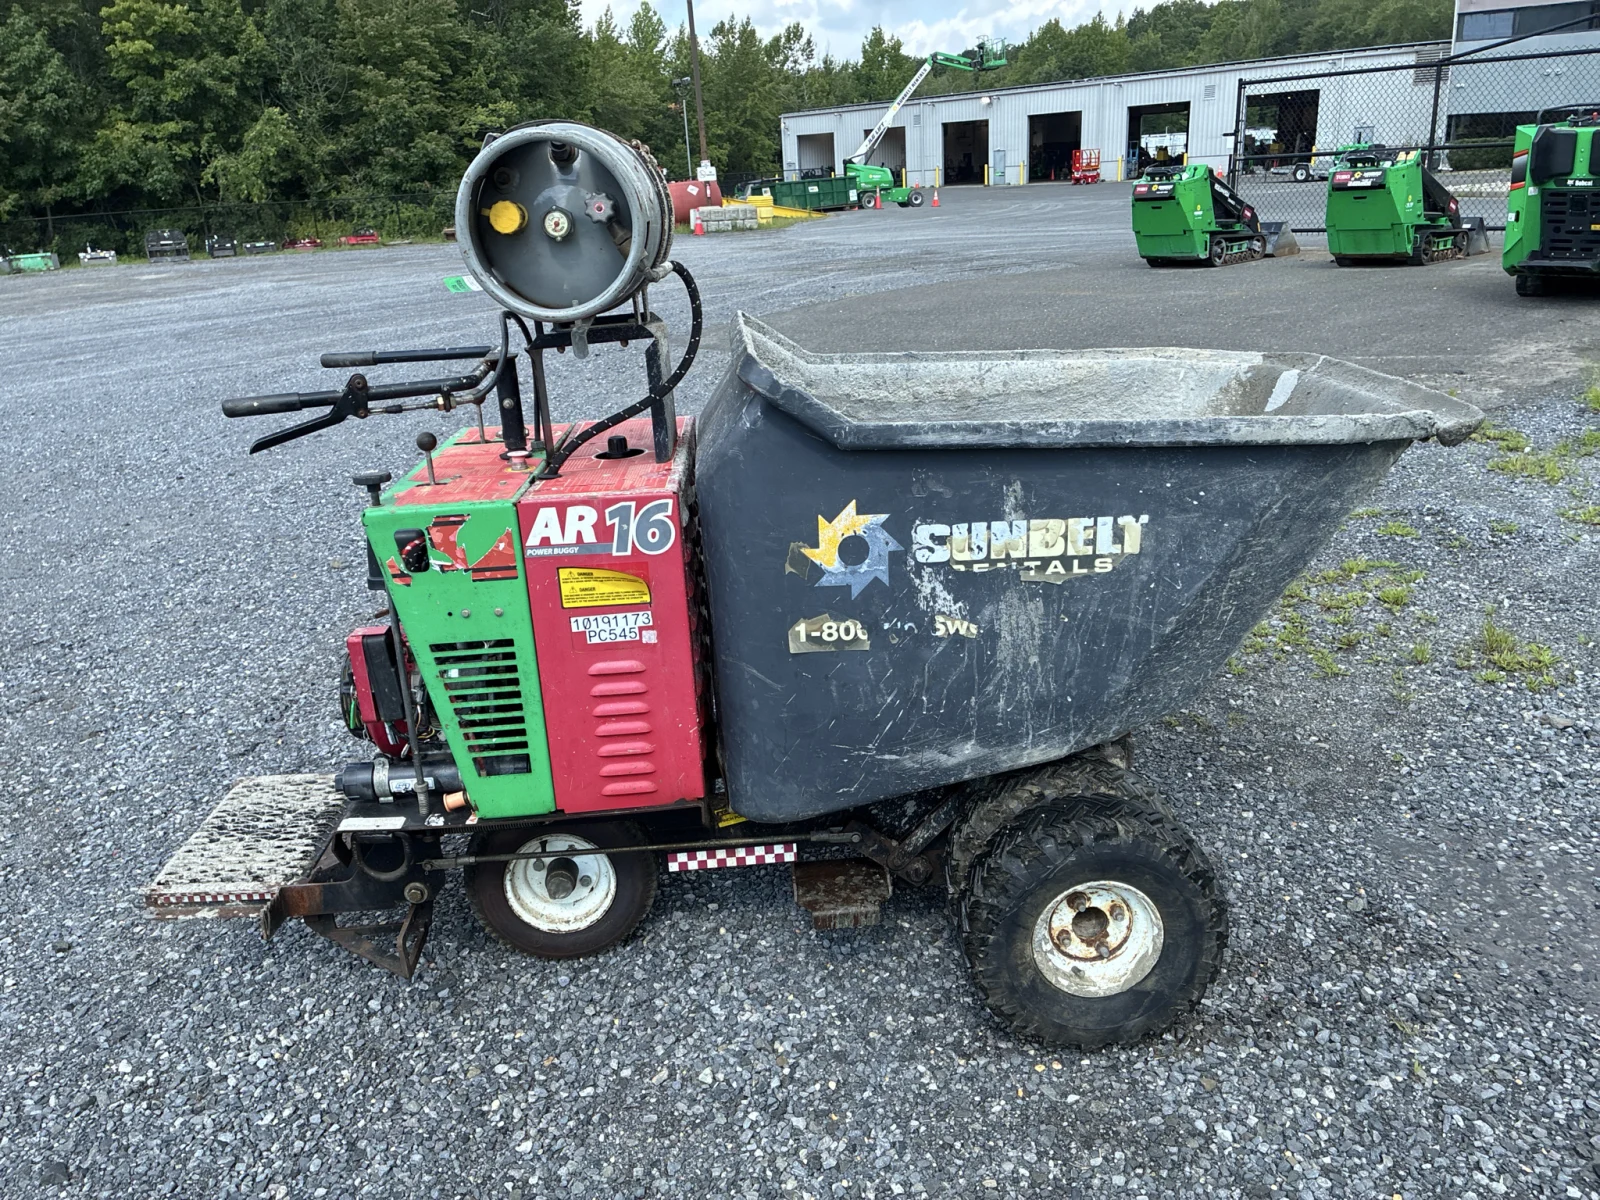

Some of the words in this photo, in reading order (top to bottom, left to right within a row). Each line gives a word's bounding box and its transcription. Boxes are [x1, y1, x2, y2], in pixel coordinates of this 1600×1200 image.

[914, 514, 1149, 563] SUNBELT
[527, 548, 552, 556] POWER
[553, 546, 579, 555] BUGGY
[572, 613, 651, 631] 10191173
[588, 627, 638, 643] PC545
